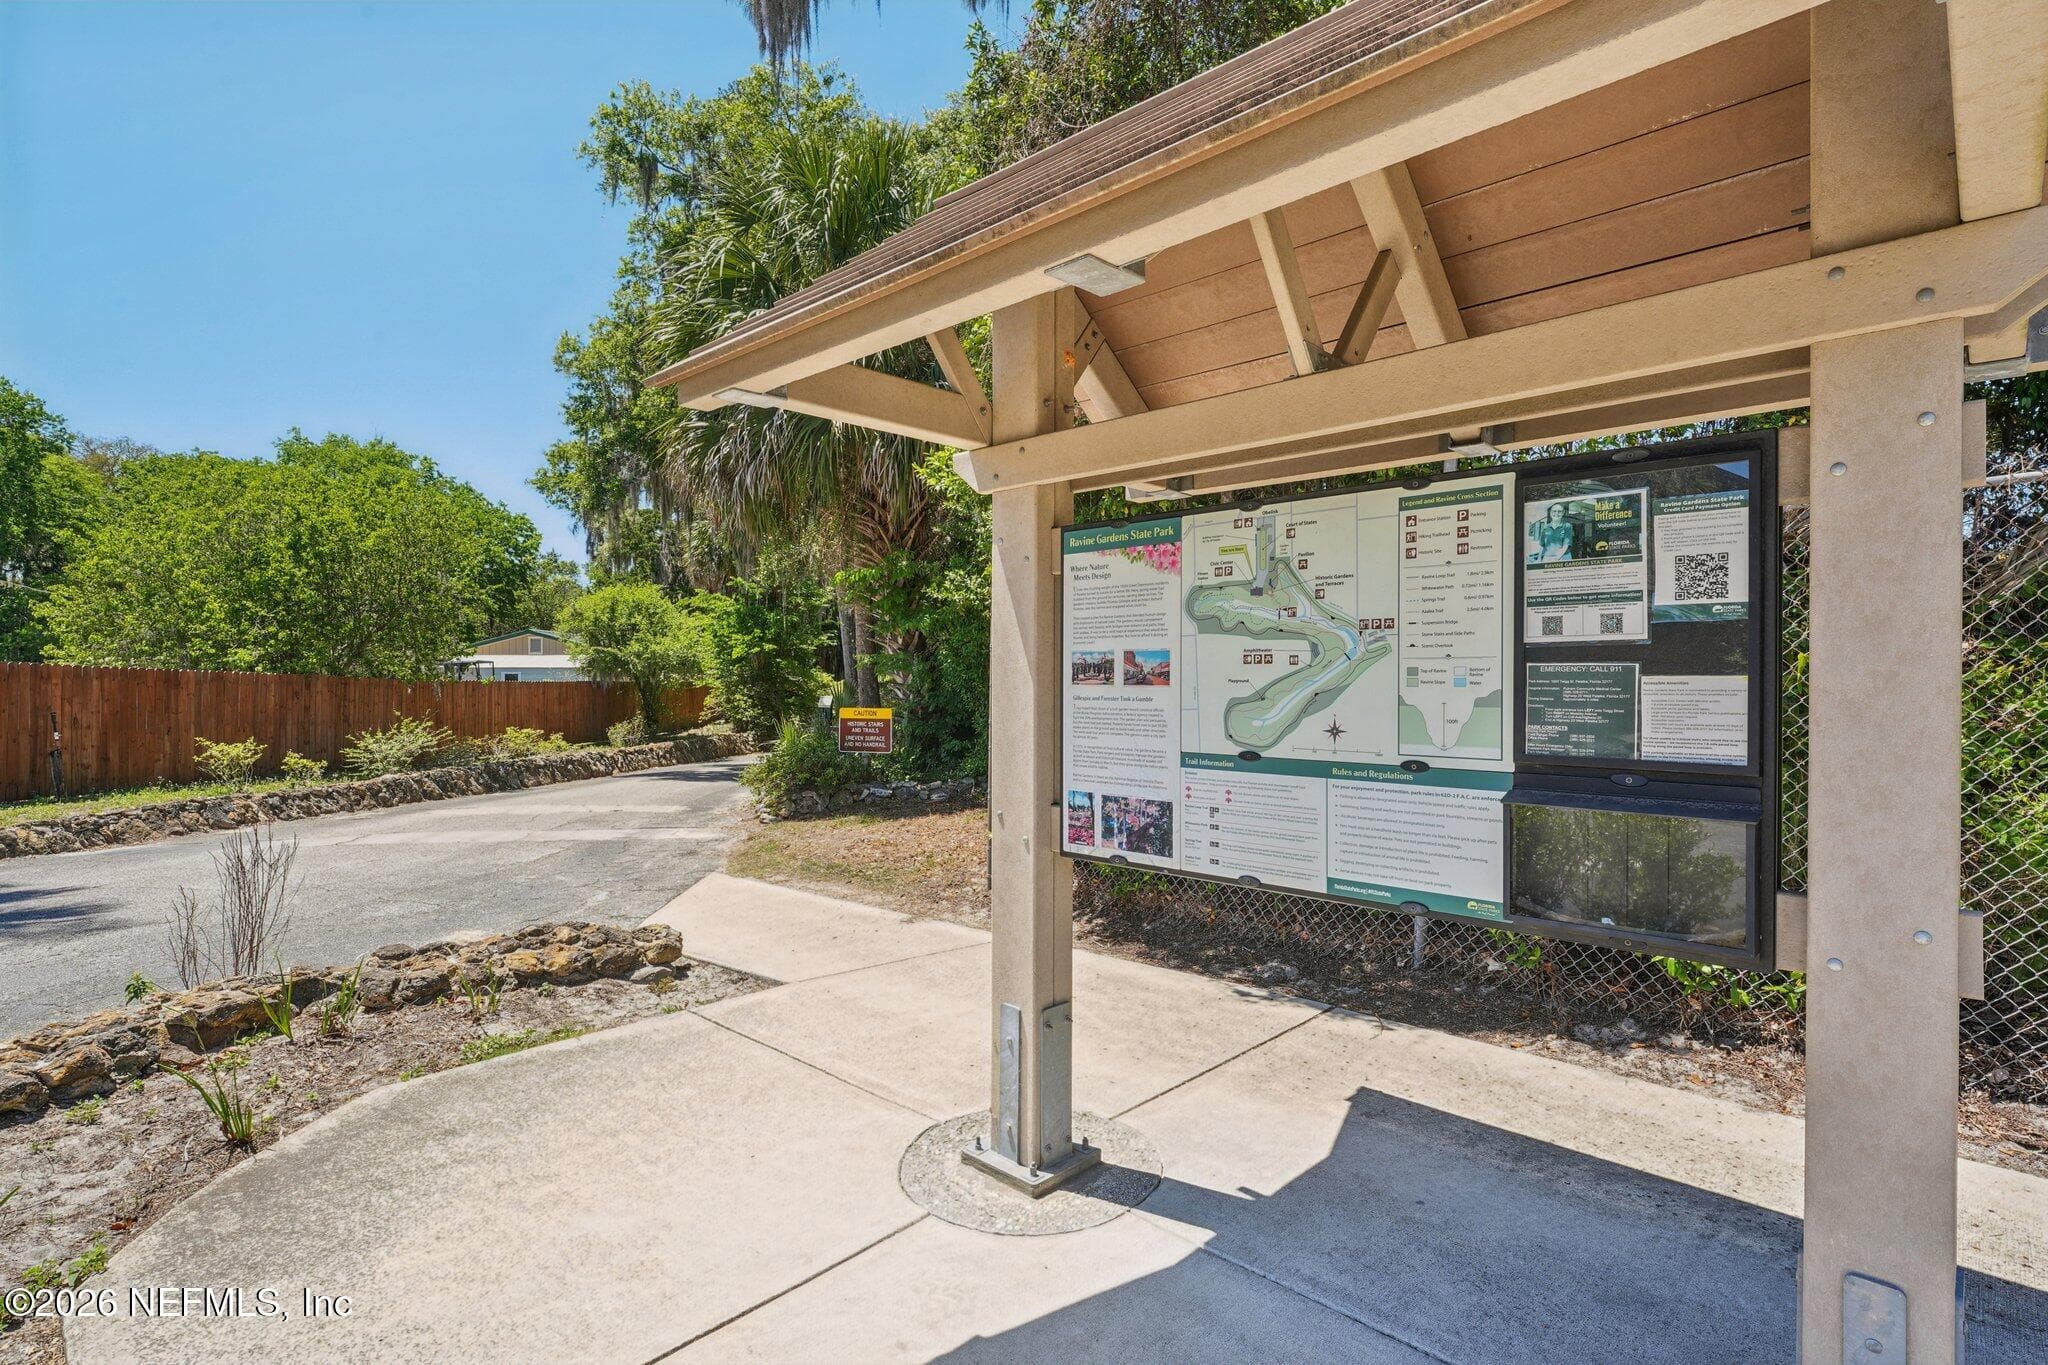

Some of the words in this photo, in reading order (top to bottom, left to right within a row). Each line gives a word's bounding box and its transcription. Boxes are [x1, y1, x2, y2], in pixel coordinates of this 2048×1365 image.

[1595, 501, 1614, 511] Make
[1595, 510, 1632, 521] Difference
[1070, 537, 1095, 548] Ravine
[1097, 532, 1128, 545] Gardens
[1131, 529, 1152, 540] State
[1154, 526, 1174, 537] Park
[1073, 573, 1091, 581] Meets
[1092, 572, 1111, 580] Design
[1200, 759, 1234, 767] Information
[1333, 768, 1352, 776] Rules
[1369, 770, 1413, 780] Regulations
